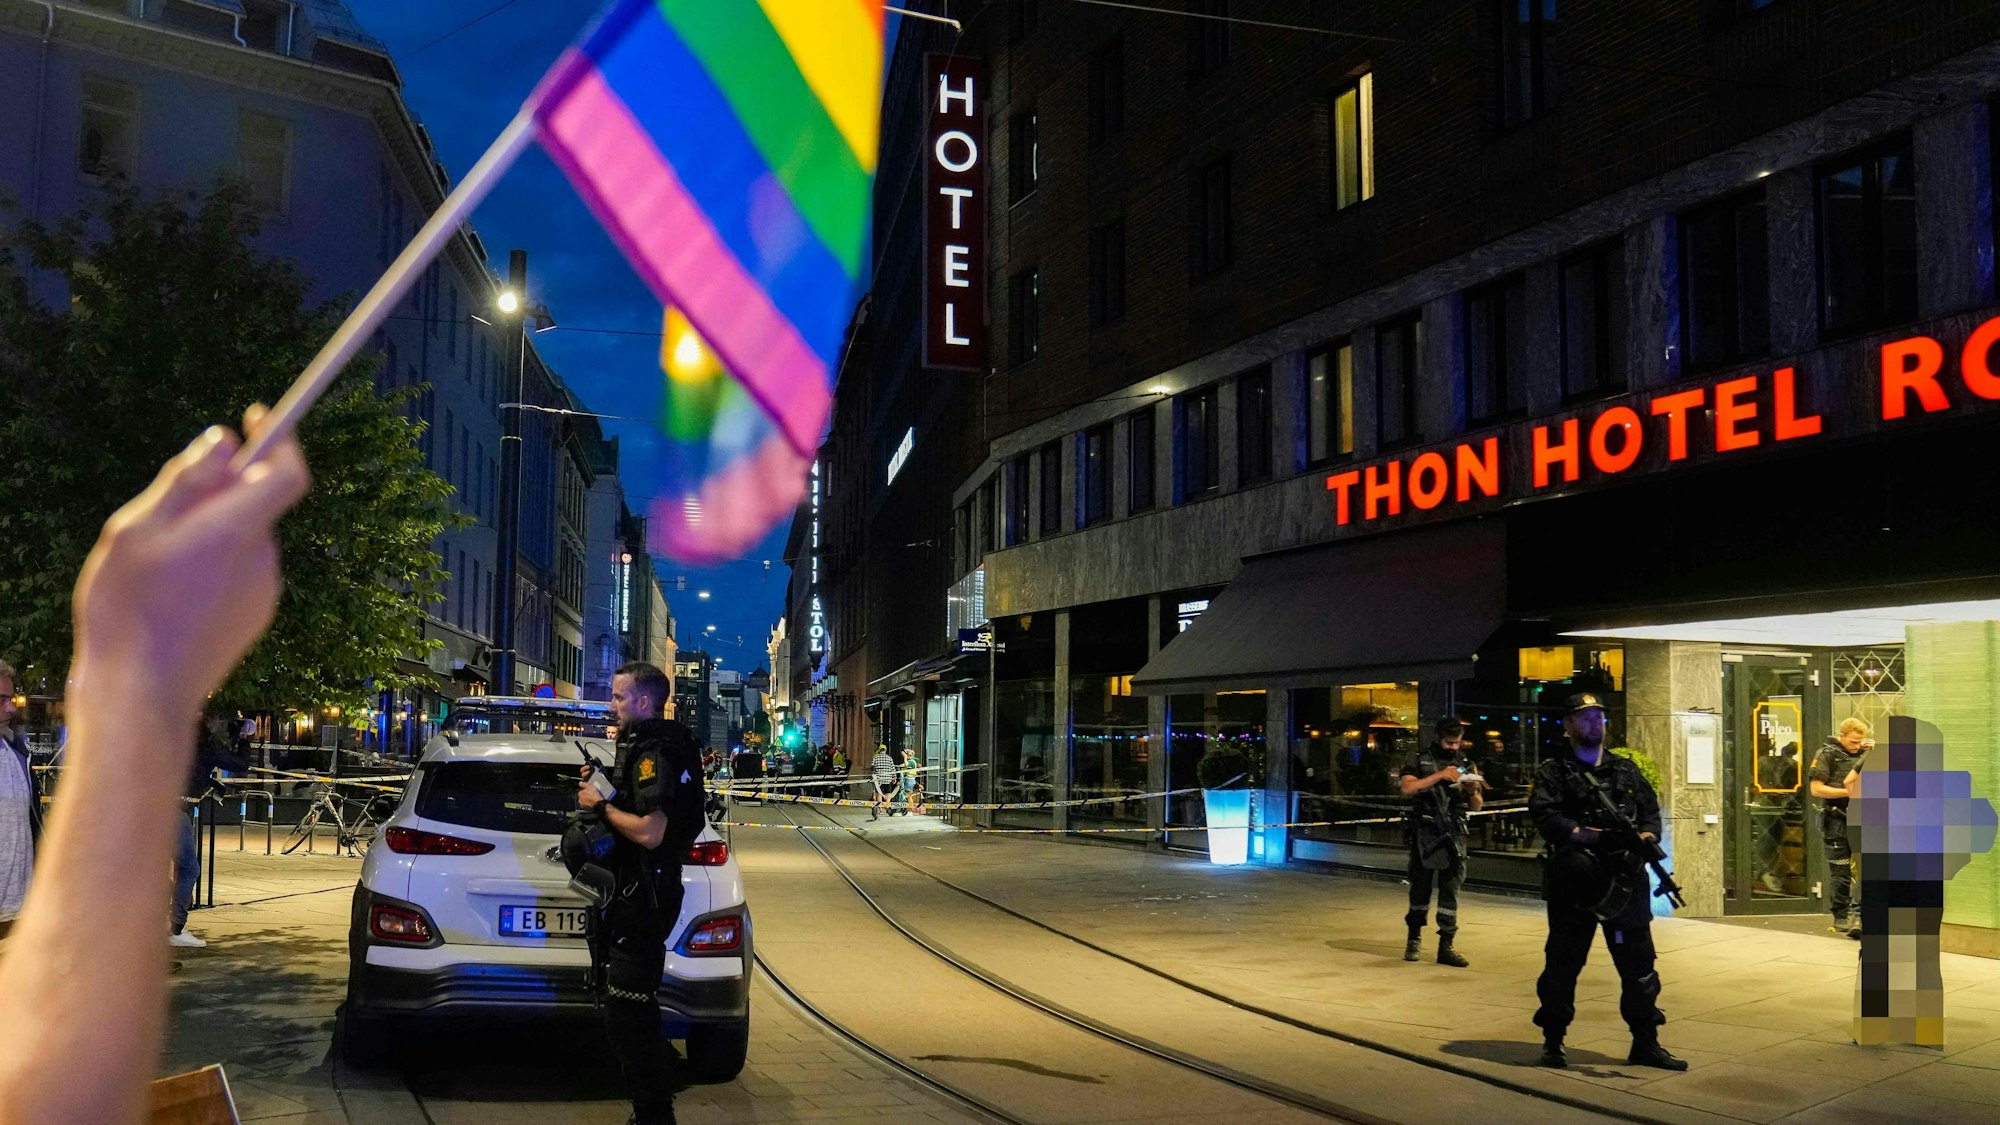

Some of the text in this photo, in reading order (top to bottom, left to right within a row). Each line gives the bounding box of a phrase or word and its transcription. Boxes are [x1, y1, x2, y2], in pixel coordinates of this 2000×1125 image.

[935, 73, 978, 346] HOTEL
[1326, 437, 1499, 526] THON
[1532, 367, 1823, 488] HOTEL
[1760, 719, 1792, 735] Paleo
[522, 911, 546, 929] EB
